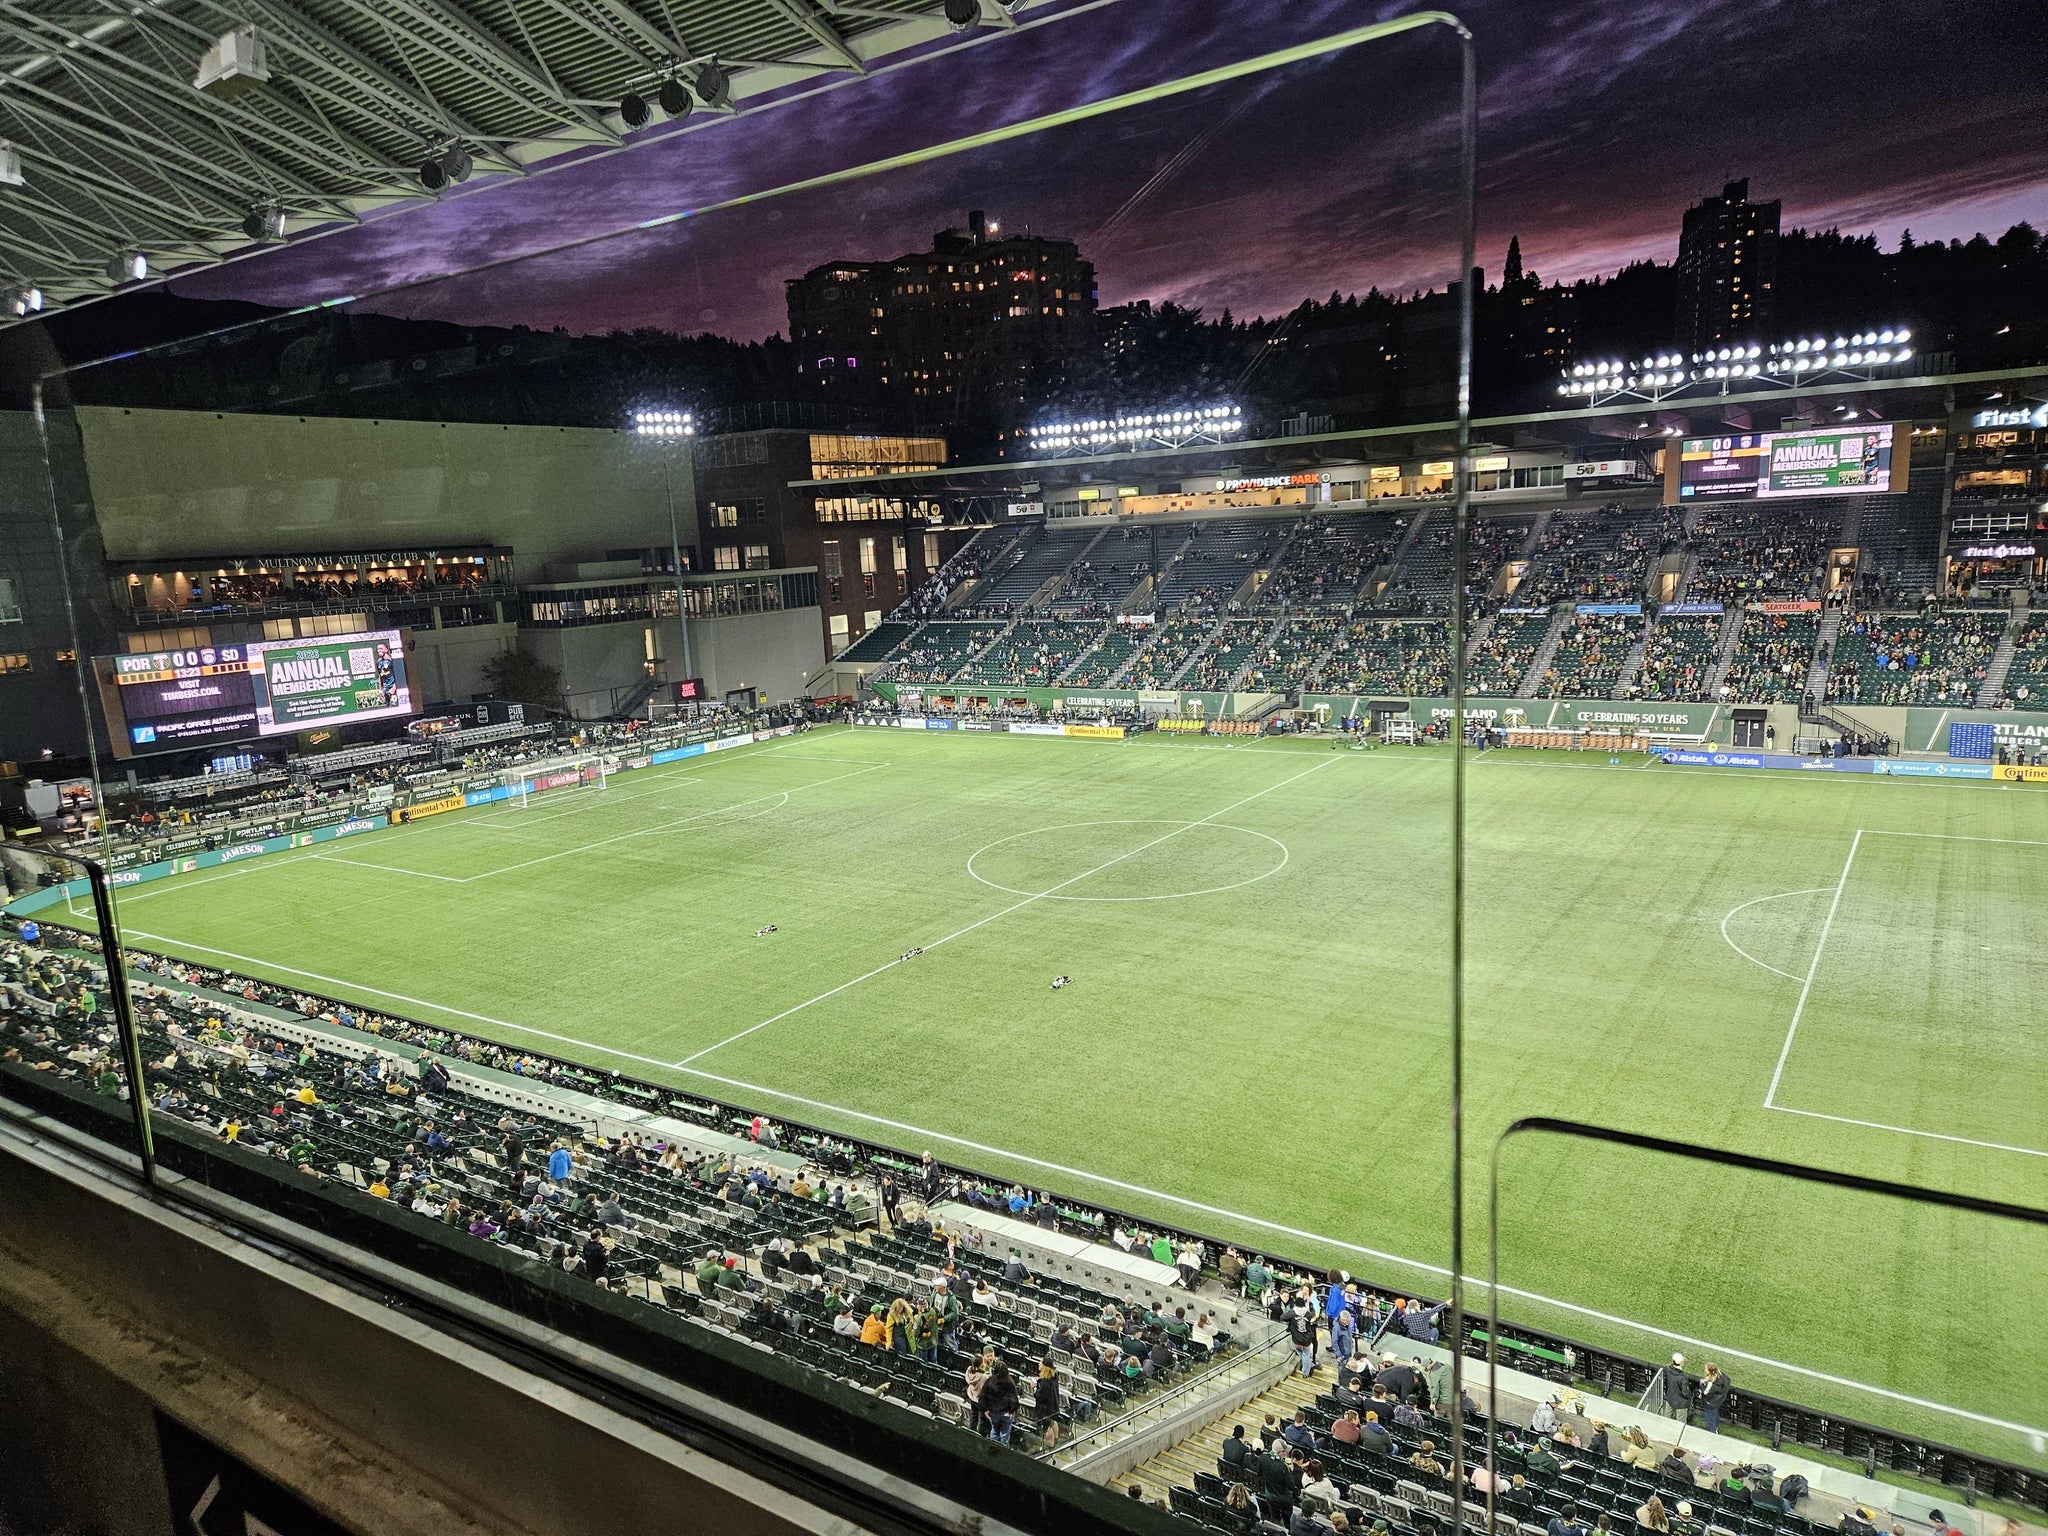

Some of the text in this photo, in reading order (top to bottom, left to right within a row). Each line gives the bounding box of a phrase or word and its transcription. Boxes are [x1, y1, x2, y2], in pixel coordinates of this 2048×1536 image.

[1980, 407, 2031, 427] First
[1712, 437, 1732, 450] 0 0
[1912, 437, 1938, 447] 215
[1774, 444, 1838, 462] ANNUAL
[1773, 459, 1838, 472] MEMBERSHIPS
[1967, 546, 2035, 557] First Tech
[258, 552, 418, 569] MULTNOMAH ATHLETIC CLUB
[349, 606, 369, 614] CITY
[373, 604, 390, 613] USA
[1765, 603, 1801, 611] SEATGEEK
[122, 649, 239, 672] POR 0 0 SD
[296, 649, 320, 661] 2026
[272, 656, 349, 684] ANNUAL
[178, 679, 201, 689] VISIT
[272, 676, 352, 697] MEMBERSHIPS
[1066, 697, 1135, 708] CELEBRATING 50 YEARS
[508, 707, 524, 715] PUB
[1432, 708, 1498, 720] PORLAND
[157, 713, 256, 733] PACIFIC OFFICE AUTOMATION
[1578, 711, 1689, 725] CELEBRATING 50 YEARS
[177, 724, 240, 737] PROBLEM SOLVED
[1070, 727, 1101, 736] Continental
[717, 739, 738, 749] axiom
[1677, 754, 1709, 763] Allstate
[1727, 757, 1760, 765] Allstate
[445, 799, 461, 808] Tire
[299, 813, 329, 825] CELEBRATING
[236, 824, 273, 837] PORTLAND
[335, 820, 374, 837] JAMESON
[166, 838, 200, 851] CELEBRATING
[221, 844, 264, 863] JAMESON
